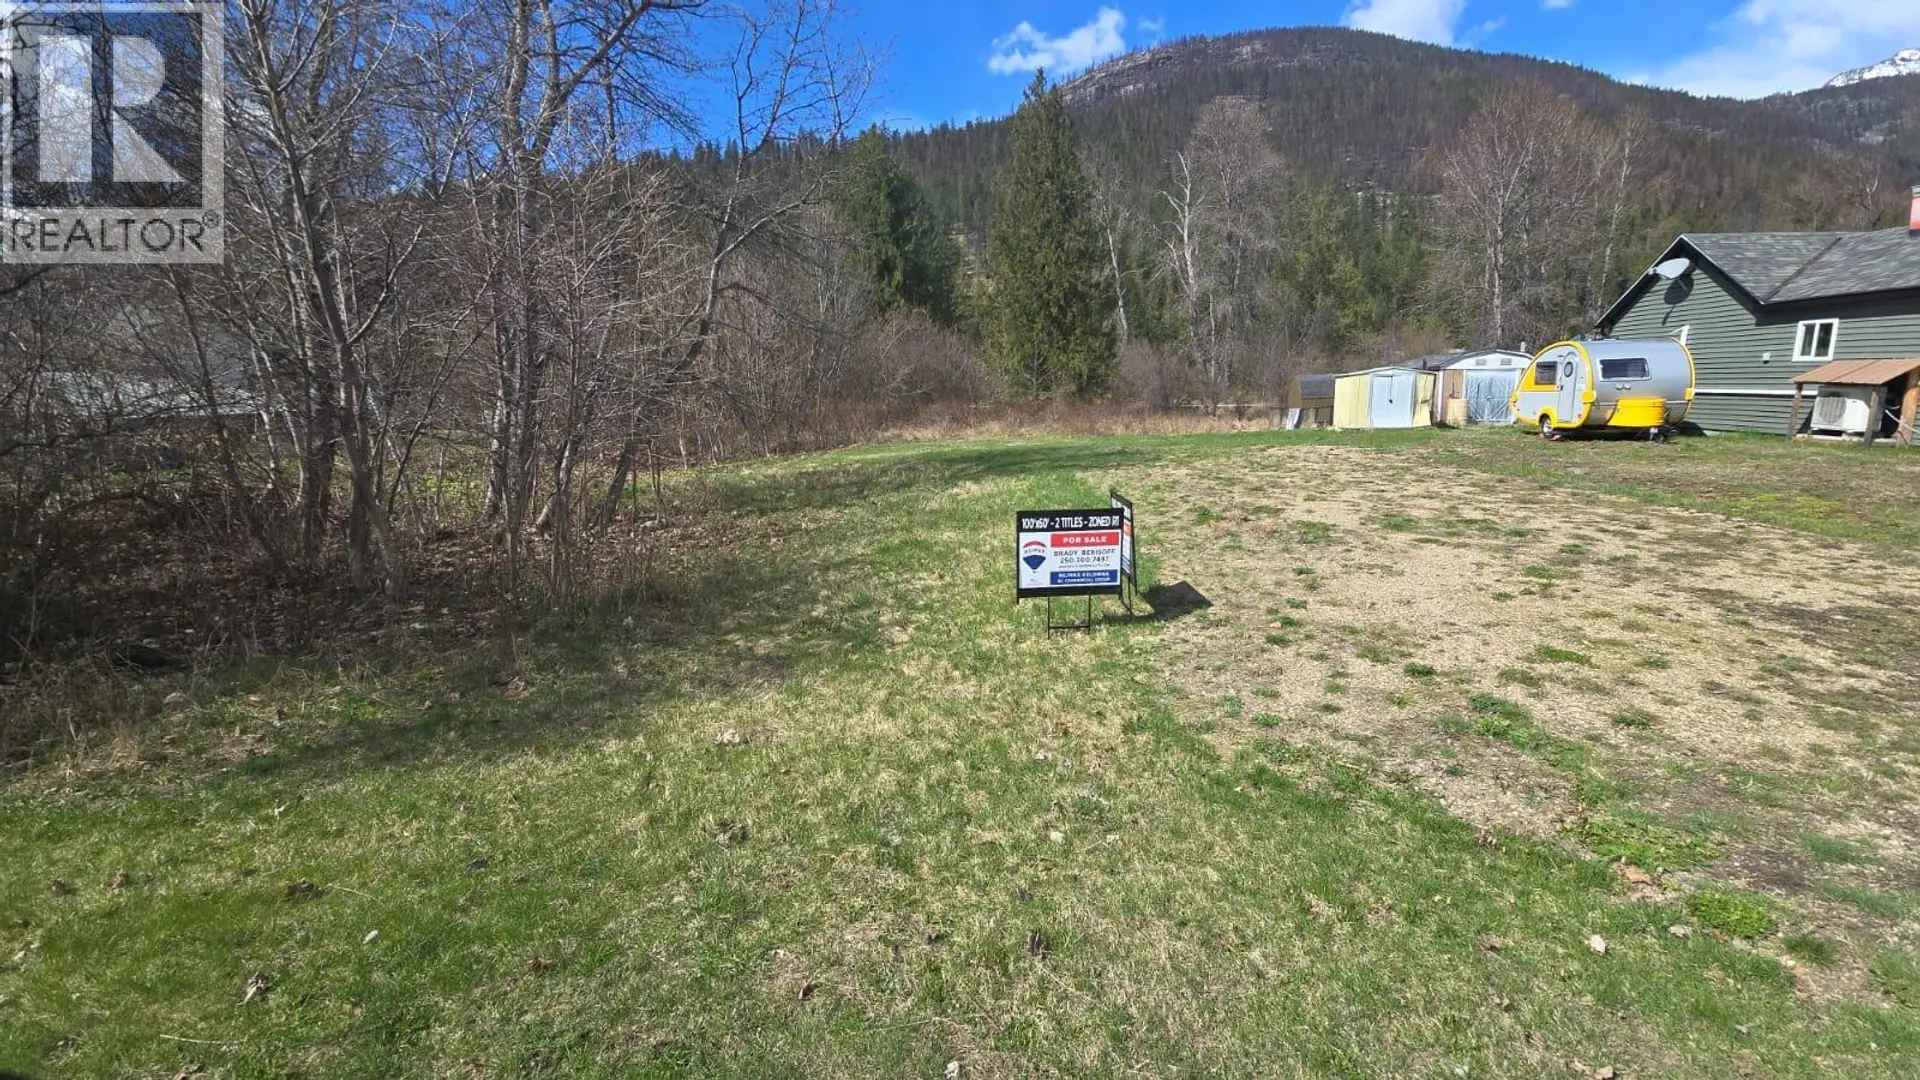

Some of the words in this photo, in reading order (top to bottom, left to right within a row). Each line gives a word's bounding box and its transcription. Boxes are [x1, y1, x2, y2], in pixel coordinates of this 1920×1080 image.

[1055, 517, 1060, 528] 2
[1061, 516, 1083, 528] TITLES
[1088, 515, 1111, 527] ZONED
[1063, 536, 1082, 544] FOR
[1083, 535, 1107, 543] SALE
[1053, 549, 1079, 557] BRADY
